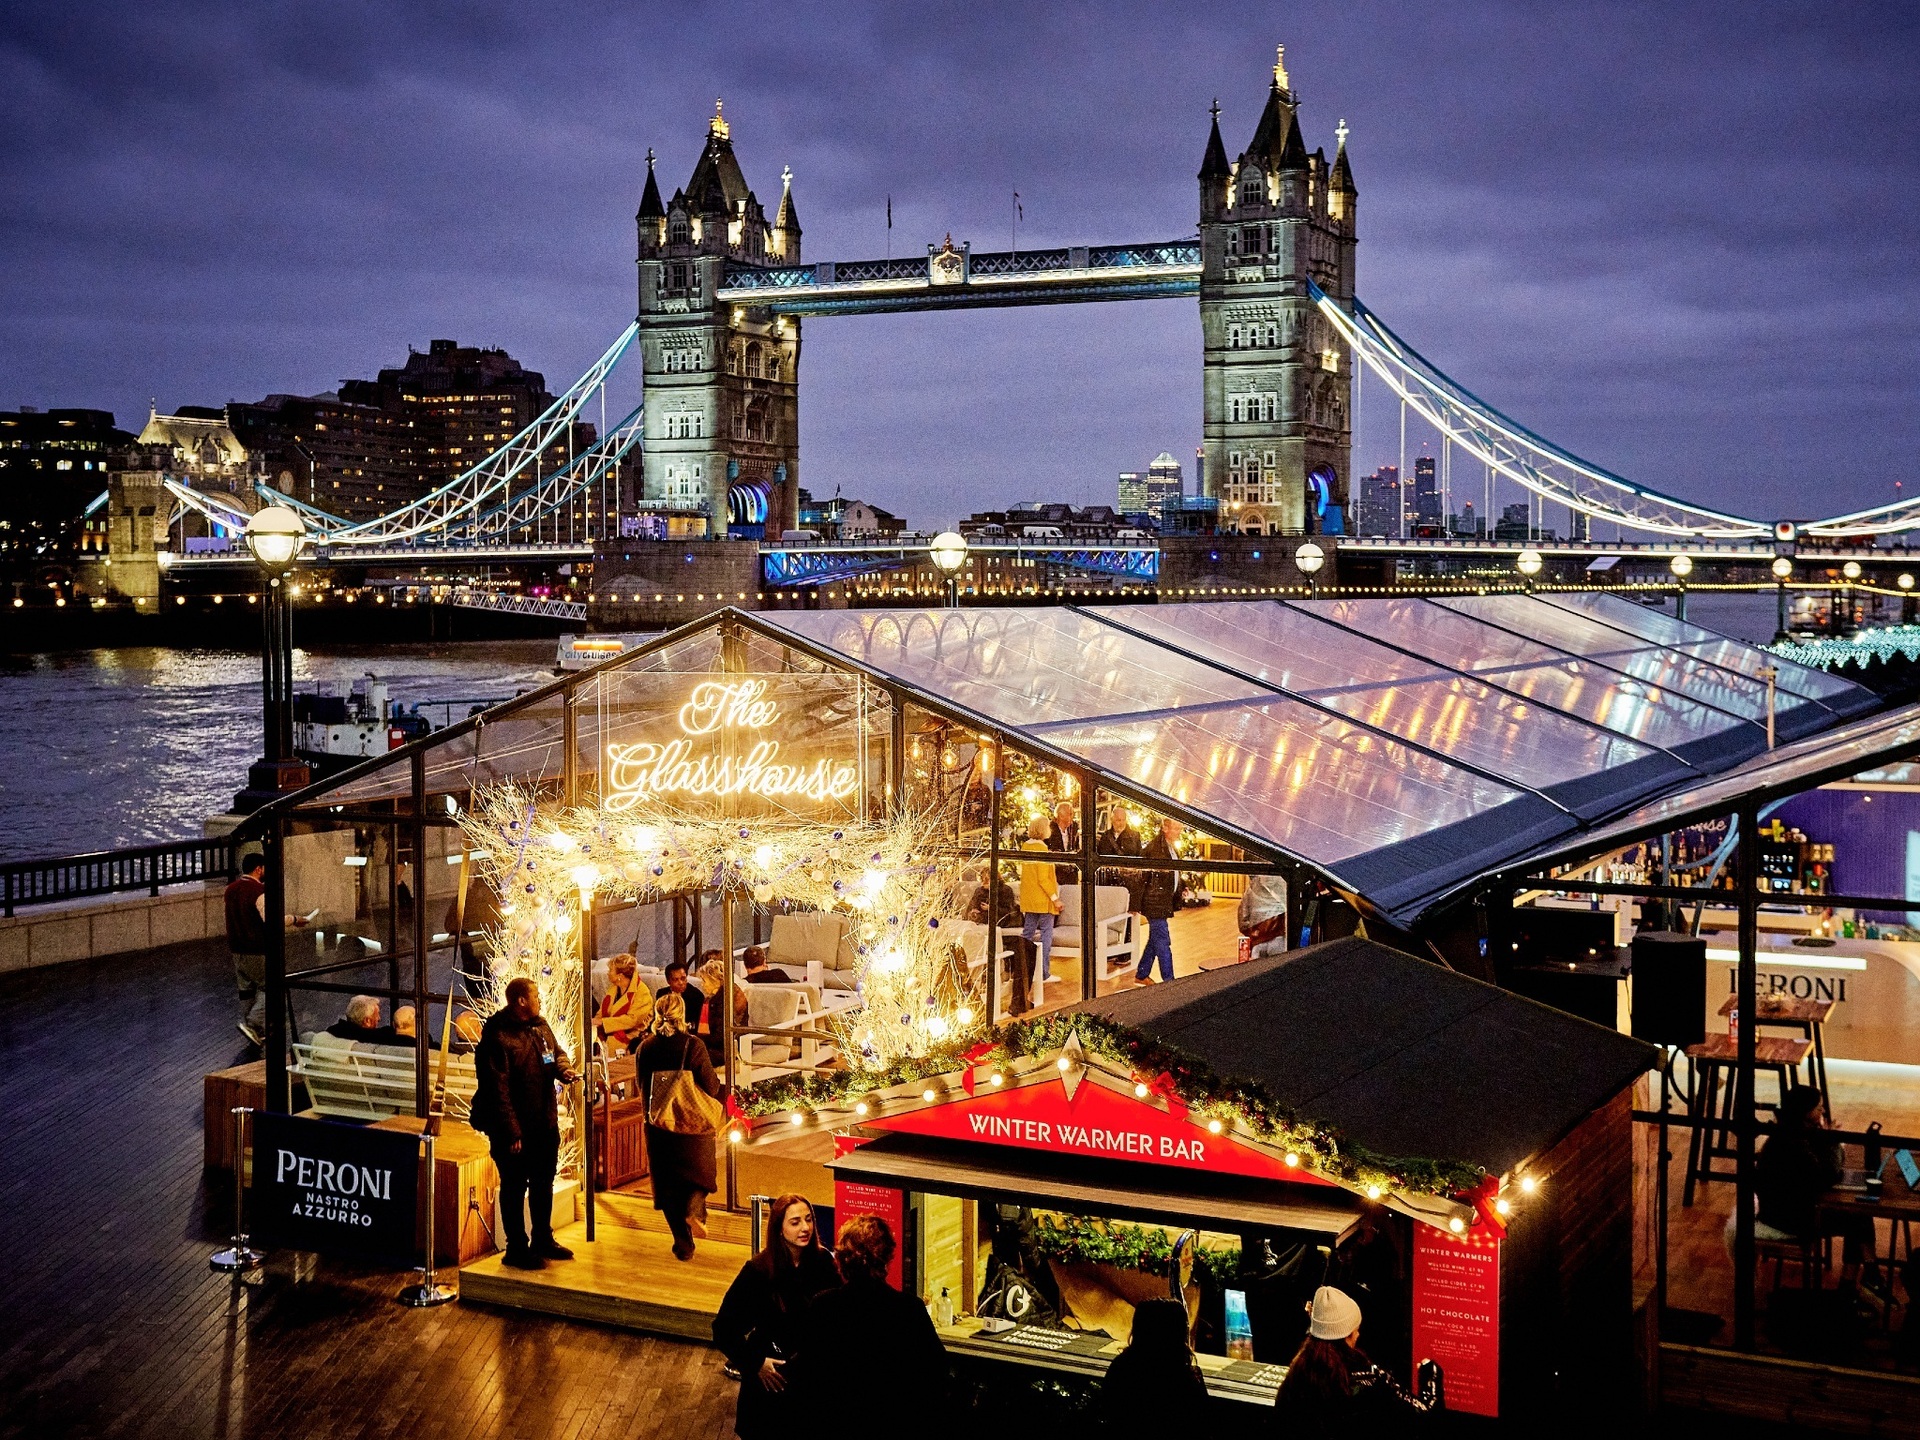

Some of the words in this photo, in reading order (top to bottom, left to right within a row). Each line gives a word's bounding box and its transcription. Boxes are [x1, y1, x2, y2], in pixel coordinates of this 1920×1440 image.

[680, 679, 780, 735] The
[604, 739, 860, 813] Glasshouse
[967, 1113, 1052, 1143] WINTER
[1056, 1125, 1154, 1156] WARMER
[1160, 1136, 1205, 1162] BAR
[277, 1149, 393, 1200] PERONI
[292, 1203, 372, 1227] AZZURRO
[306, 1192, 359, 1210] NASTRO
[1420, 1247, 1450, 1256] WINTER
[1453, 1251, 1492, 1262] WARMERS
[1440, 1310, 1490, 1322] CHOCOLATE
